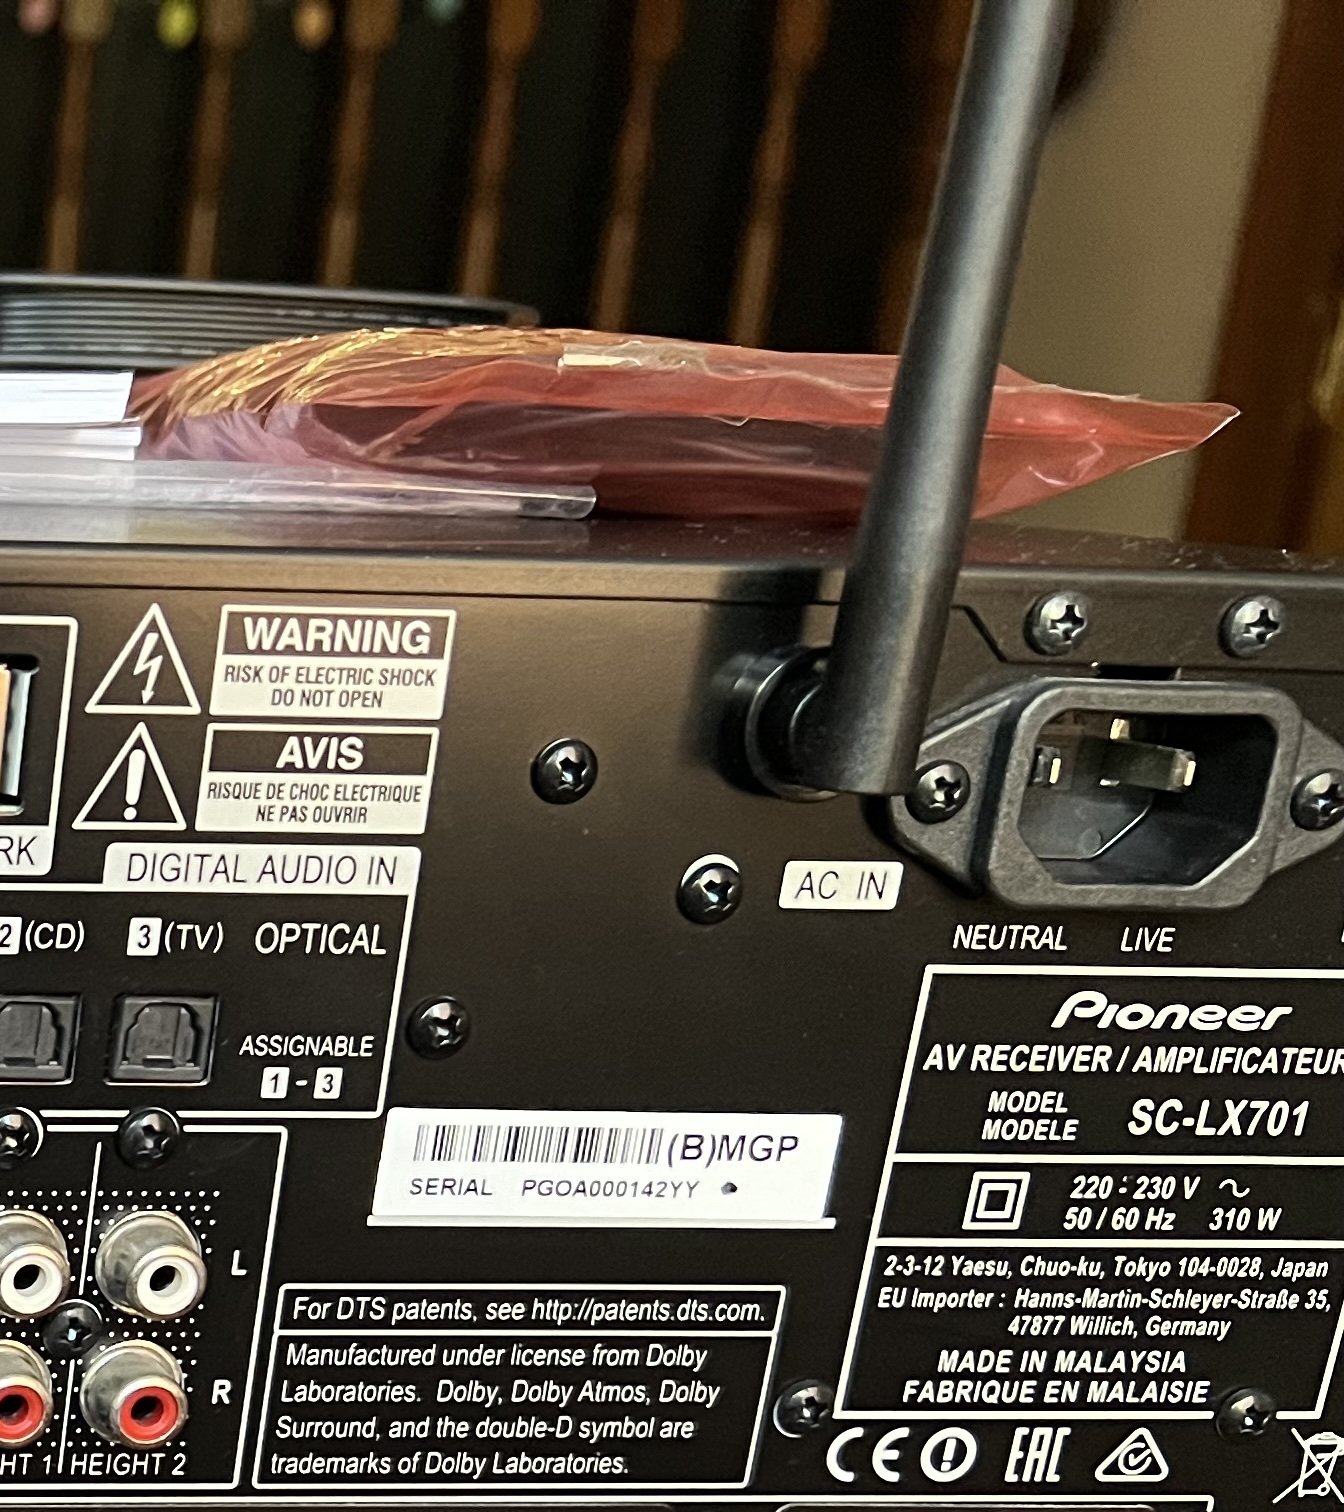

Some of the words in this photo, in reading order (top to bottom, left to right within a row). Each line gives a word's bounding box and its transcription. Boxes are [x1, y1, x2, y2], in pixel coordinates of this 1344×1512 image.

[244, 617, 431, 654] WARNING
[224, 665, 263, 682] RISK
[269, 666, 290, 683] OF
[295, 667, 373, 685] ELECTRIC
[378, 668, 436, 686] SHOCK
[271, 689, 294, 706] DO
[300, 690, 334, 707] NOT
[339, 690, 383, 708] OPEN
[276, 736, 363, 770] AVIS
[208, 782, 262, 800] RISQUE
[266, 783, 285, 800] DE
[290, 783, 329, 801] CHOC
[334, 784, 422, 803] ELECTRIQUE
[256, 805, 275, 821] NE
[279, 806, 308, 822] PAS
[313, 806, 367, 823] OUVRIR
[127, 853, 246, 883] DIGITAL
[257, 855, 356, 884] AUDIO
[368, 857, 397, 885] IN
[255, 922, 386, 954] OPTICAL
[953, 925, 1067, 950] NEUTRAL
[1051, 991, 1292, 1031] Pioneer
[988, 1091, 1067, 1113] MODEL
[982, 1119, 1079, 1140] MODELE
[1128, 1099, 1309, 1136] SC-LX701
[668, 1134, 798, 1167] (B)MGP
[410, 1178, 492, 1195] SERIAL
[884, 1255, 944, 1276] 2-3-12
[952, 1256, 1012, 1279] Yaesu,
[1021, 1255, 1104, 1279] Chuo-ku,
[1115, 1256, 1171, 1282] Tokyo
[1179, 1257, 1264, 1280] 104-0028,
[1271, 1257, 1328, 1282] Japan
[293, 1297, 332, 1319] For
[337, 1297, 386, 1320] DTS
[392, 1299, 477, 1325] patents,
[486, 1303, 525, 1320] see
[532, 1298, 764, 1325] http://patents.dts.com.
[878, 1287, 907, 1308] EU
[912, 1288, 994, 1312] Importer
[1305, 1289, 1330, 1312] 35,
[1008, 1315, 1065, 1335] 47877
[1071, 1315, 1137, 1338] Willich,
[1146, 1316, 1231, 1341] Germany
[287, 1343, 436, 1366] Manufactured
[443, 1344, 505, 1366] under
[511, 1344, 585, 1366] license
[592, 1343, 639, 1366] from
[646, 1344, 707, 1372] Dolby
[938, 1350, 1013, 1372] MADE
[1020, 1350, 1047, 1372] IN
[1054, 1350, 1185, 1373] MALAYSIA
[281, 1380, 420, 1402] Laboratories.
[437, 1380, 502, 1407] Dolby,
[511, 1380, 573, 1407] Dolby
[578, 1380, 650, 1405] Atmos,
[659, 1380, 720, 1408] Dolby
[903, 1380, 1037, 1403] FABRIQUE
[1044, 1381, 1079, 1403] EN
[1087, 1381, 1210, 1403] MALAISIE
[276, 1416, 380, 1441] Surround,
[389, 1416, 430, 1438] and
[437, 1416, 469, 1438] the
[476, 1416, 572, 1438] double-D
[579, 1416, 655, 1443] symbol
[660, 1421, 694, 1438] are
[272, 1452, 391, 1474] trademarks
[398, 1452, 421, 1474] of
[425, 1452, 486, 1479] Dolby
[493, 1452, 628, 1473] Laboratories.
